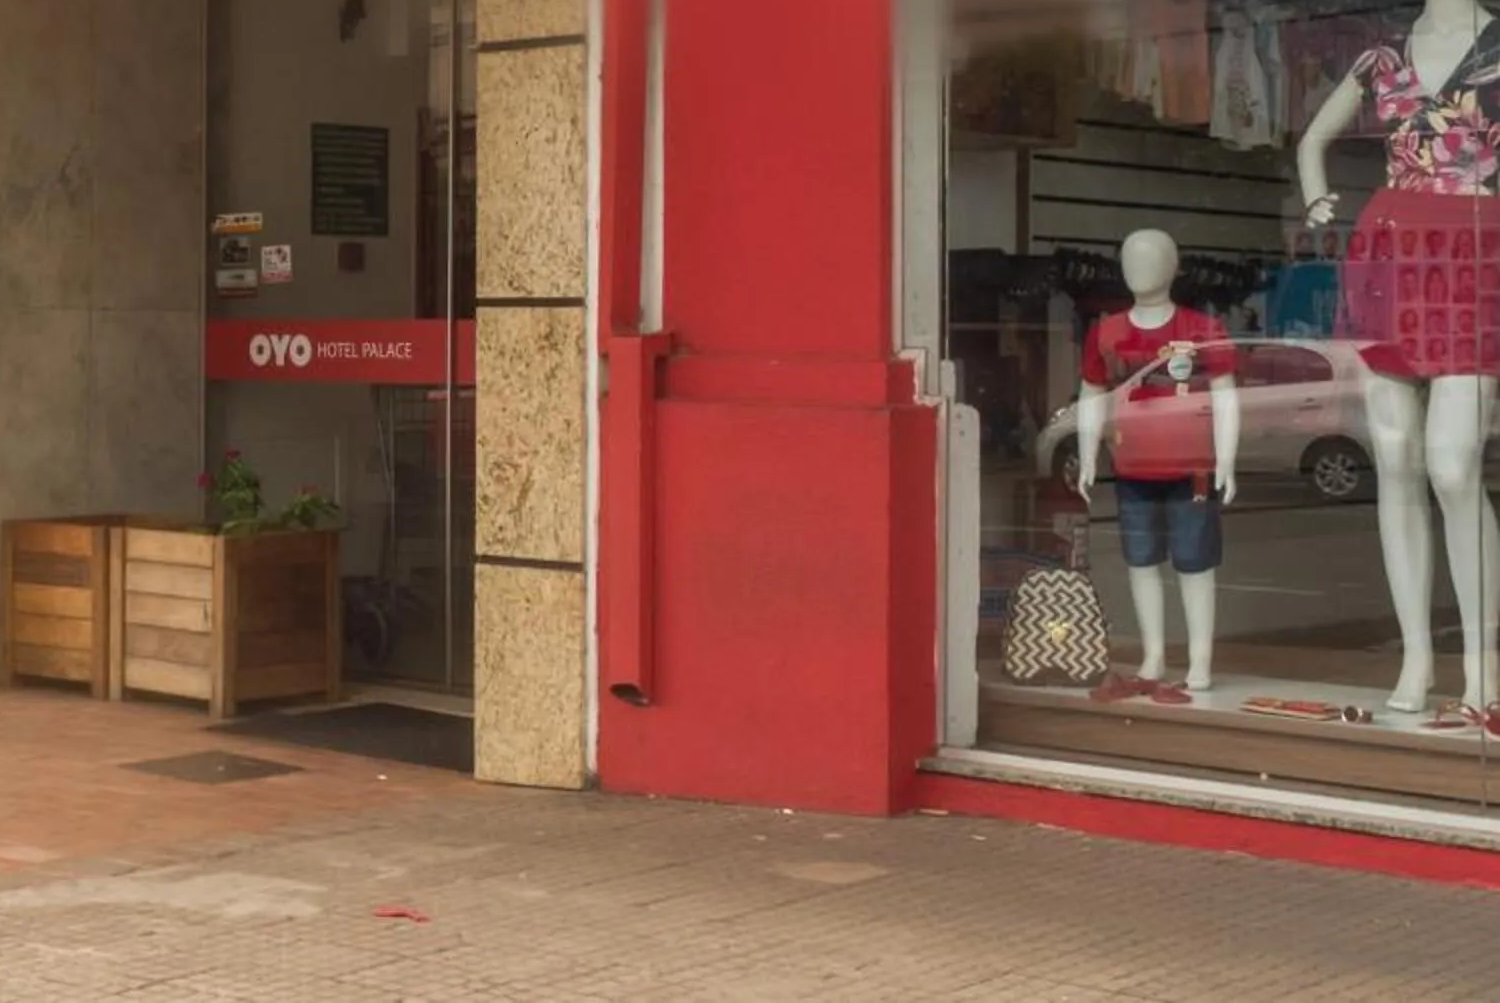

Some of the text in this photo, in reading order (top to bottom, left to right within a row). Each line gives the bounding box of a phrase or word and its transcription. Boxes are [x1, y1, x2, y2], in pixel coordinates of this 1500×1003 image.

[250, 333, 412, 367] OYO HOTEL PALACE
